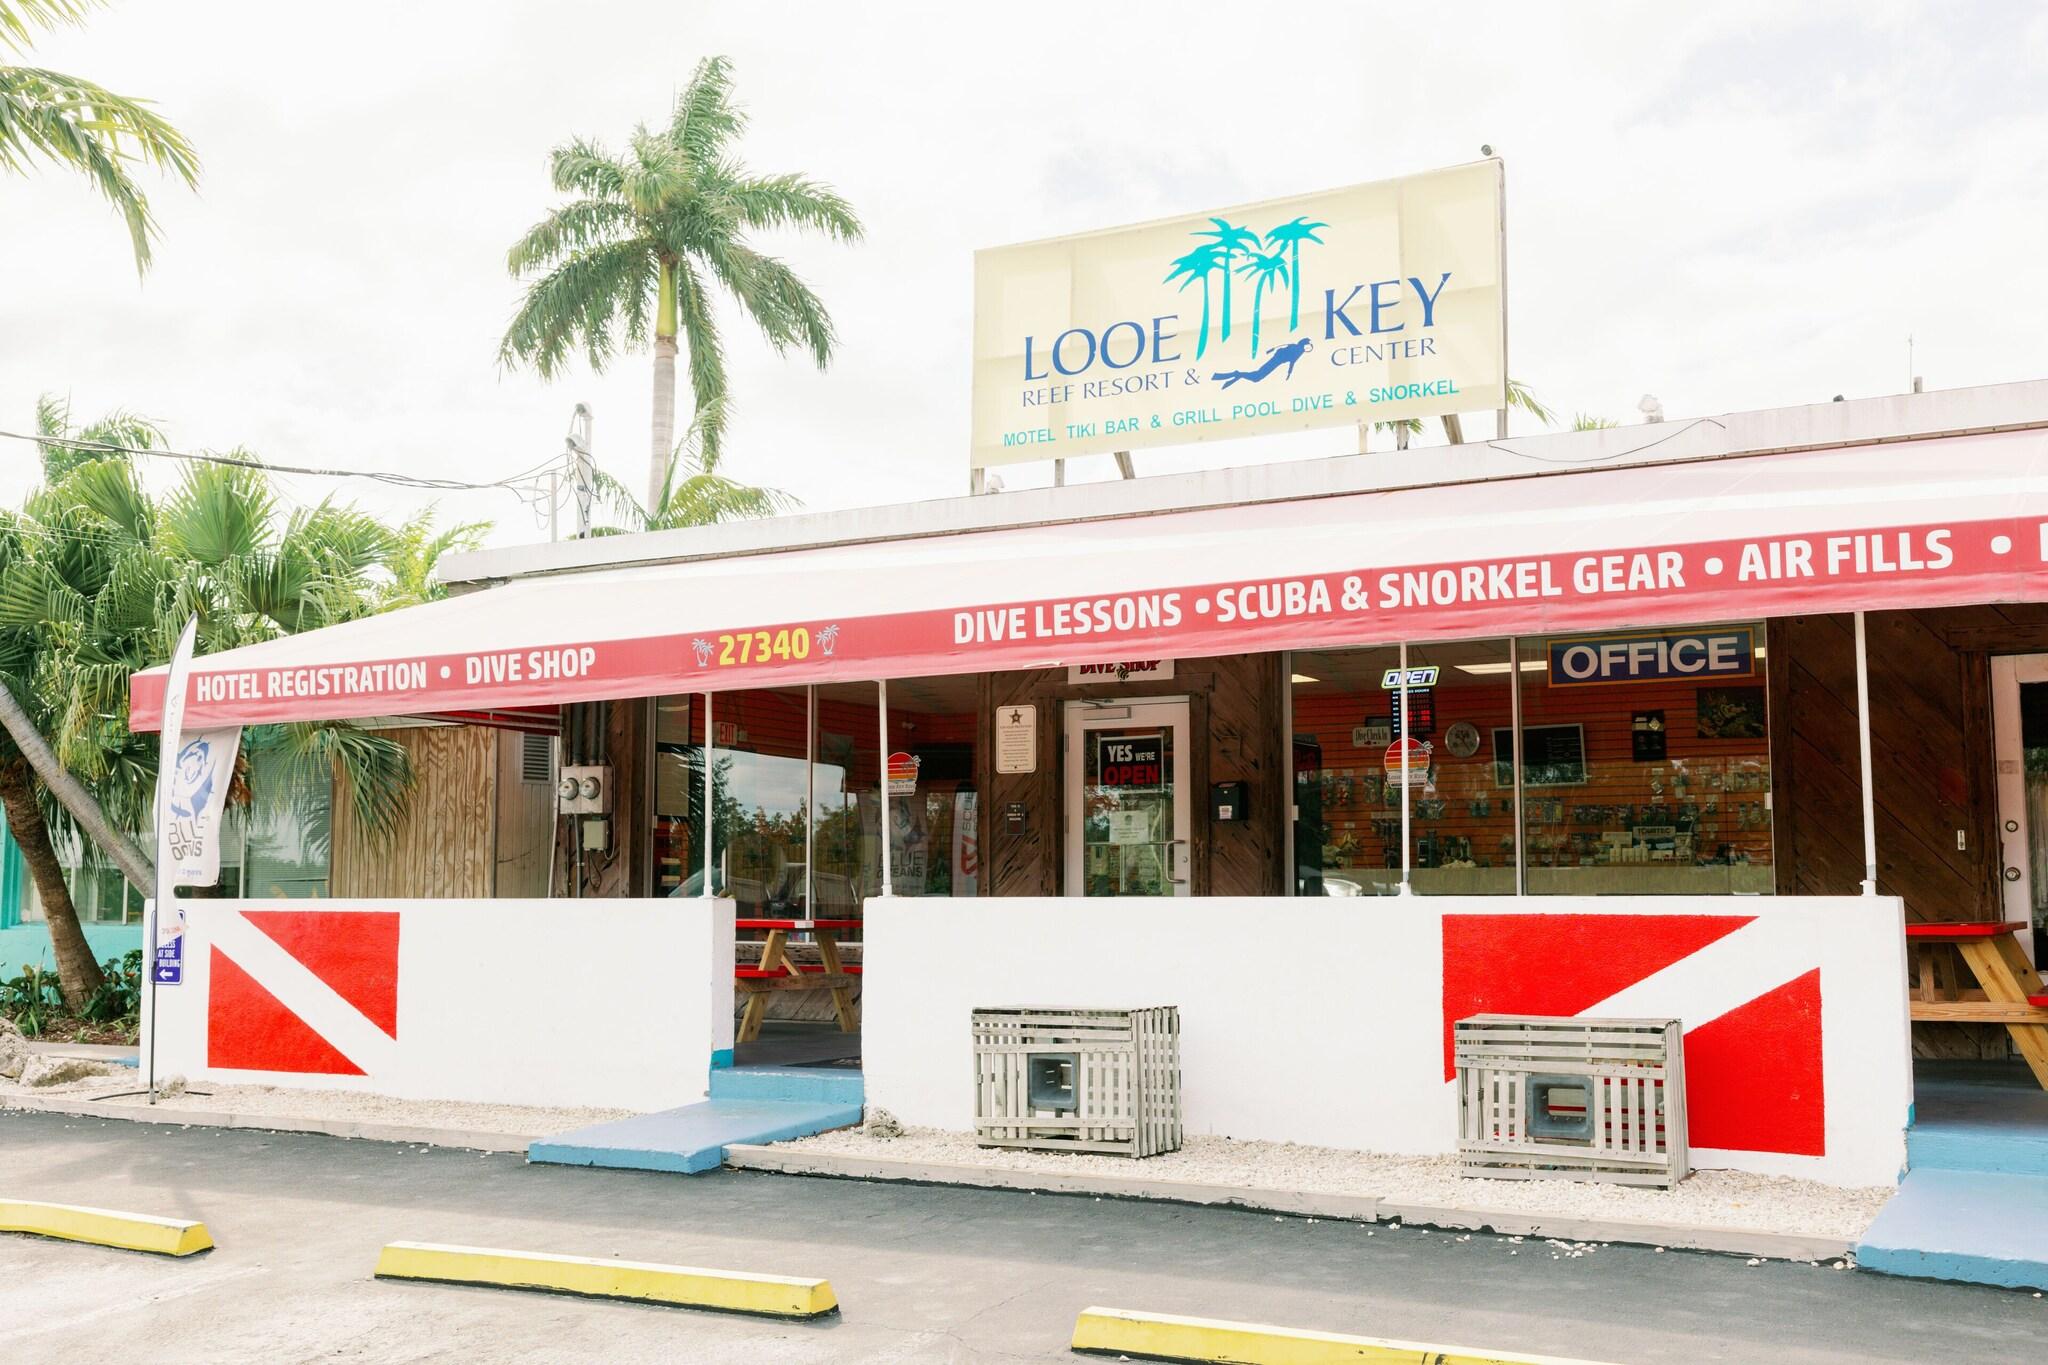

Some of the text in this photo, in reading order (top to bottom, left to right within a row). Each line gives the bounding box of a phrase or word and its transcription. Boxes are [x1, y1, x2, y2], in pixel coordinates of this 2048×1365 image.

[1024, 272, 1452, 381] LOOE KEY
[1022, 337, 1436, 407] REEF RESORT & CENTER
[1003, 379, 1460, 447] MOTEL TIKI BAR & GRILL POOL DIVE & SNORKEL
[954, 529, 1954, 645] DIVE LESSONS SCUBA & SNORKEL GEAR AIR FILLS
[718, 627, 810, 666] 27340
[1561, 635, 1740, 680] OFFICE
[197, 647, 596, 702] HOTEL REGISTRATION DIVE SHOP
[719, 723, 734, 744] EXIT
[1107, 744, 1155, 763] YES WE'RE
[1103, 765, 1160, 786] OPEN
[159, 958, 180, 968] BUILDING
[164, 949, 176, 958] SIDE
